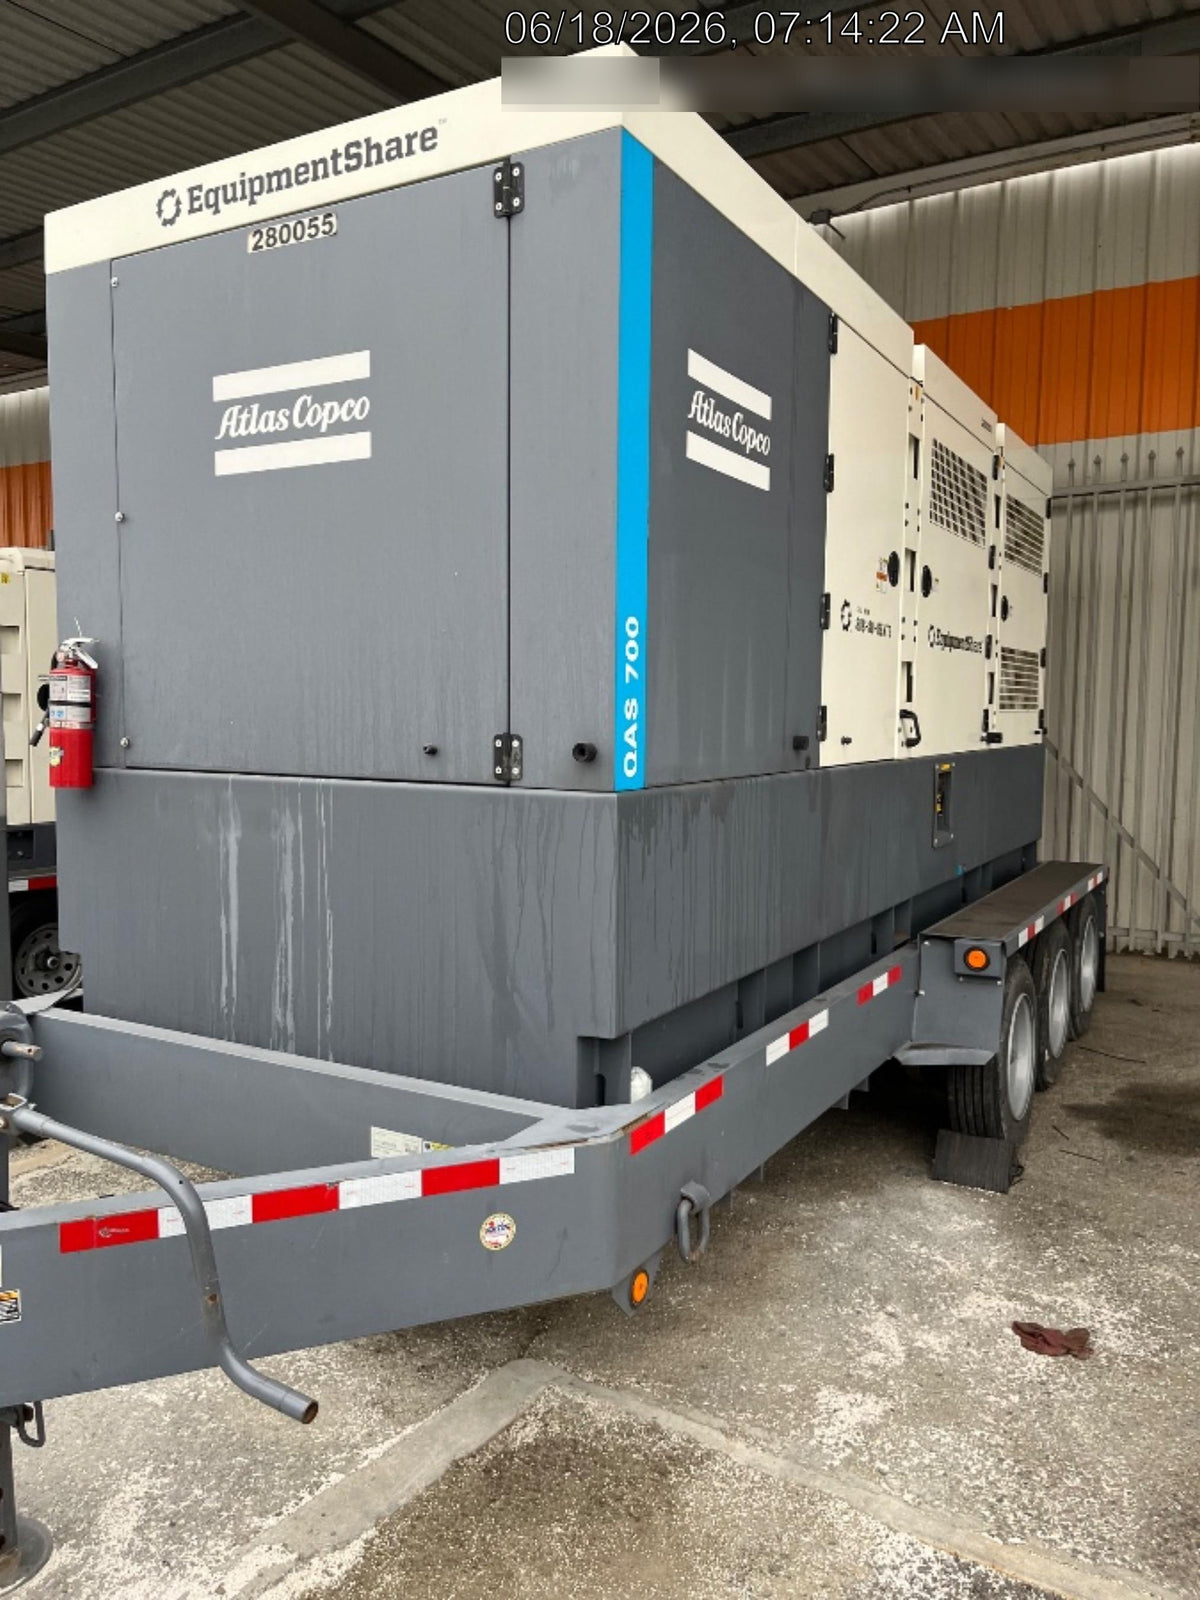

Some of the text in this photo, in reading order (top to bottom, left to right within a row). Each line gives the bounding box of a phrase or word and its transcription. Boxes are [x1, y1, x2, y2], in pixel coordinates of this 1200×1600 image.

[187, 126, 439, 215] EquipmentShare
[251, 213, 335, 252] 280055
[623, 615, 640, 778] QAS 700
